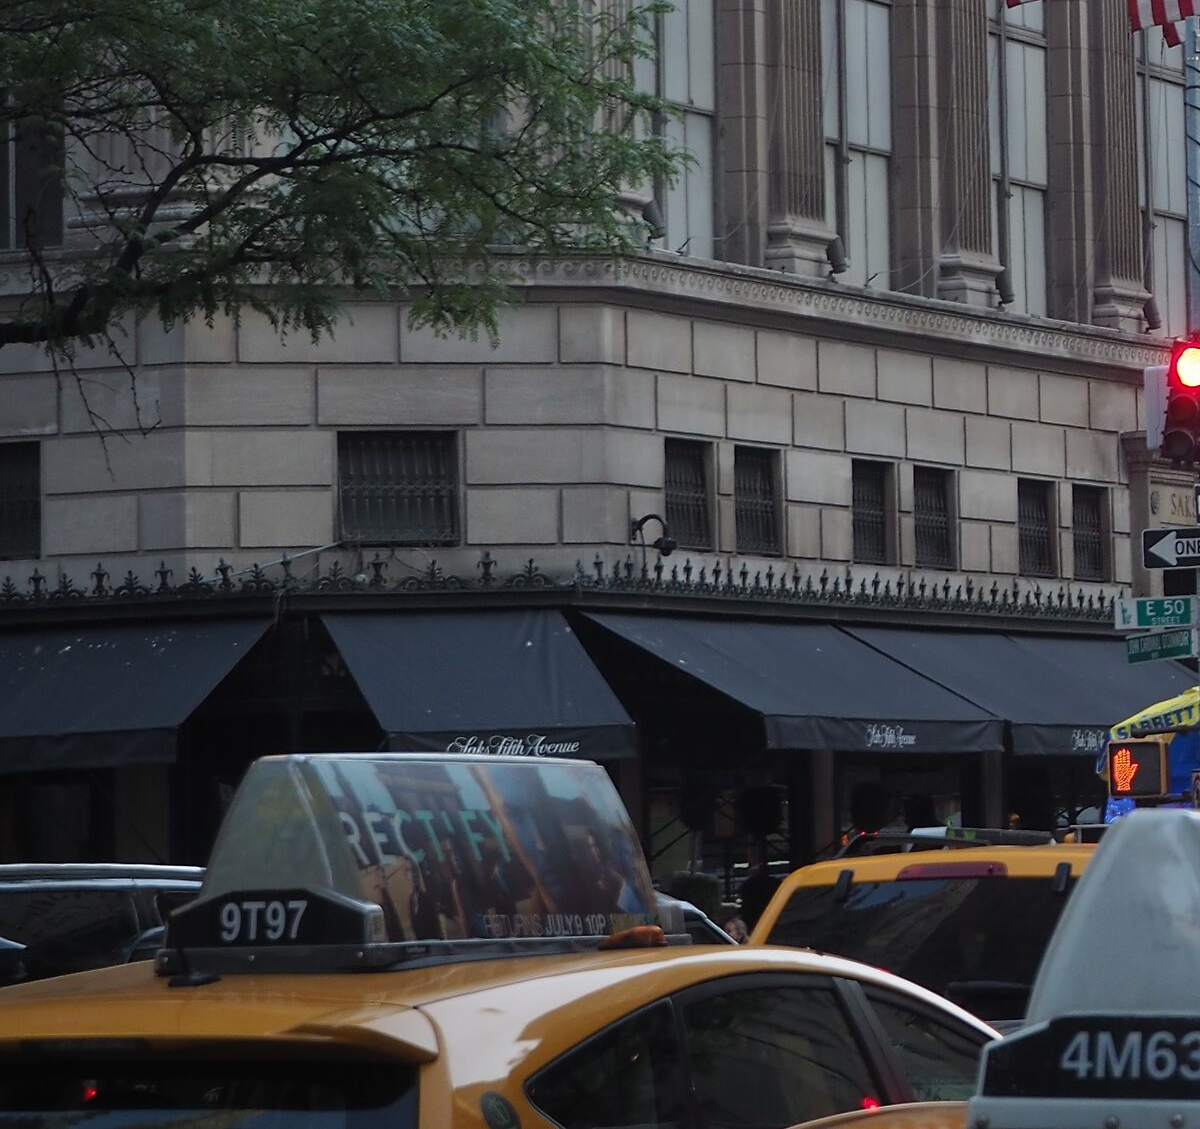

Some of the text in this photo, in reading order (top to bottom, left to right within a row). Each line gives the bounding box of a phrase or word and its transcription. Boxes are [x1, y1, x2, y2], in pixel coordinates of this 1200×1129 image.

[1146, 599, 1185, 616] E 50
[1151, 616, 1181, 626] STREET
[1116, 705, 1195, 739] SABRETT
[526, 734, 579, 756] Avenue
[220, 900, 307, 941] 9T97
[482, 913, 543, 938] RETURNS
[544, 913, 574, 937] JULY
[574, 912, 583, 935] 9
[586, 913, 607, 935] 10P
